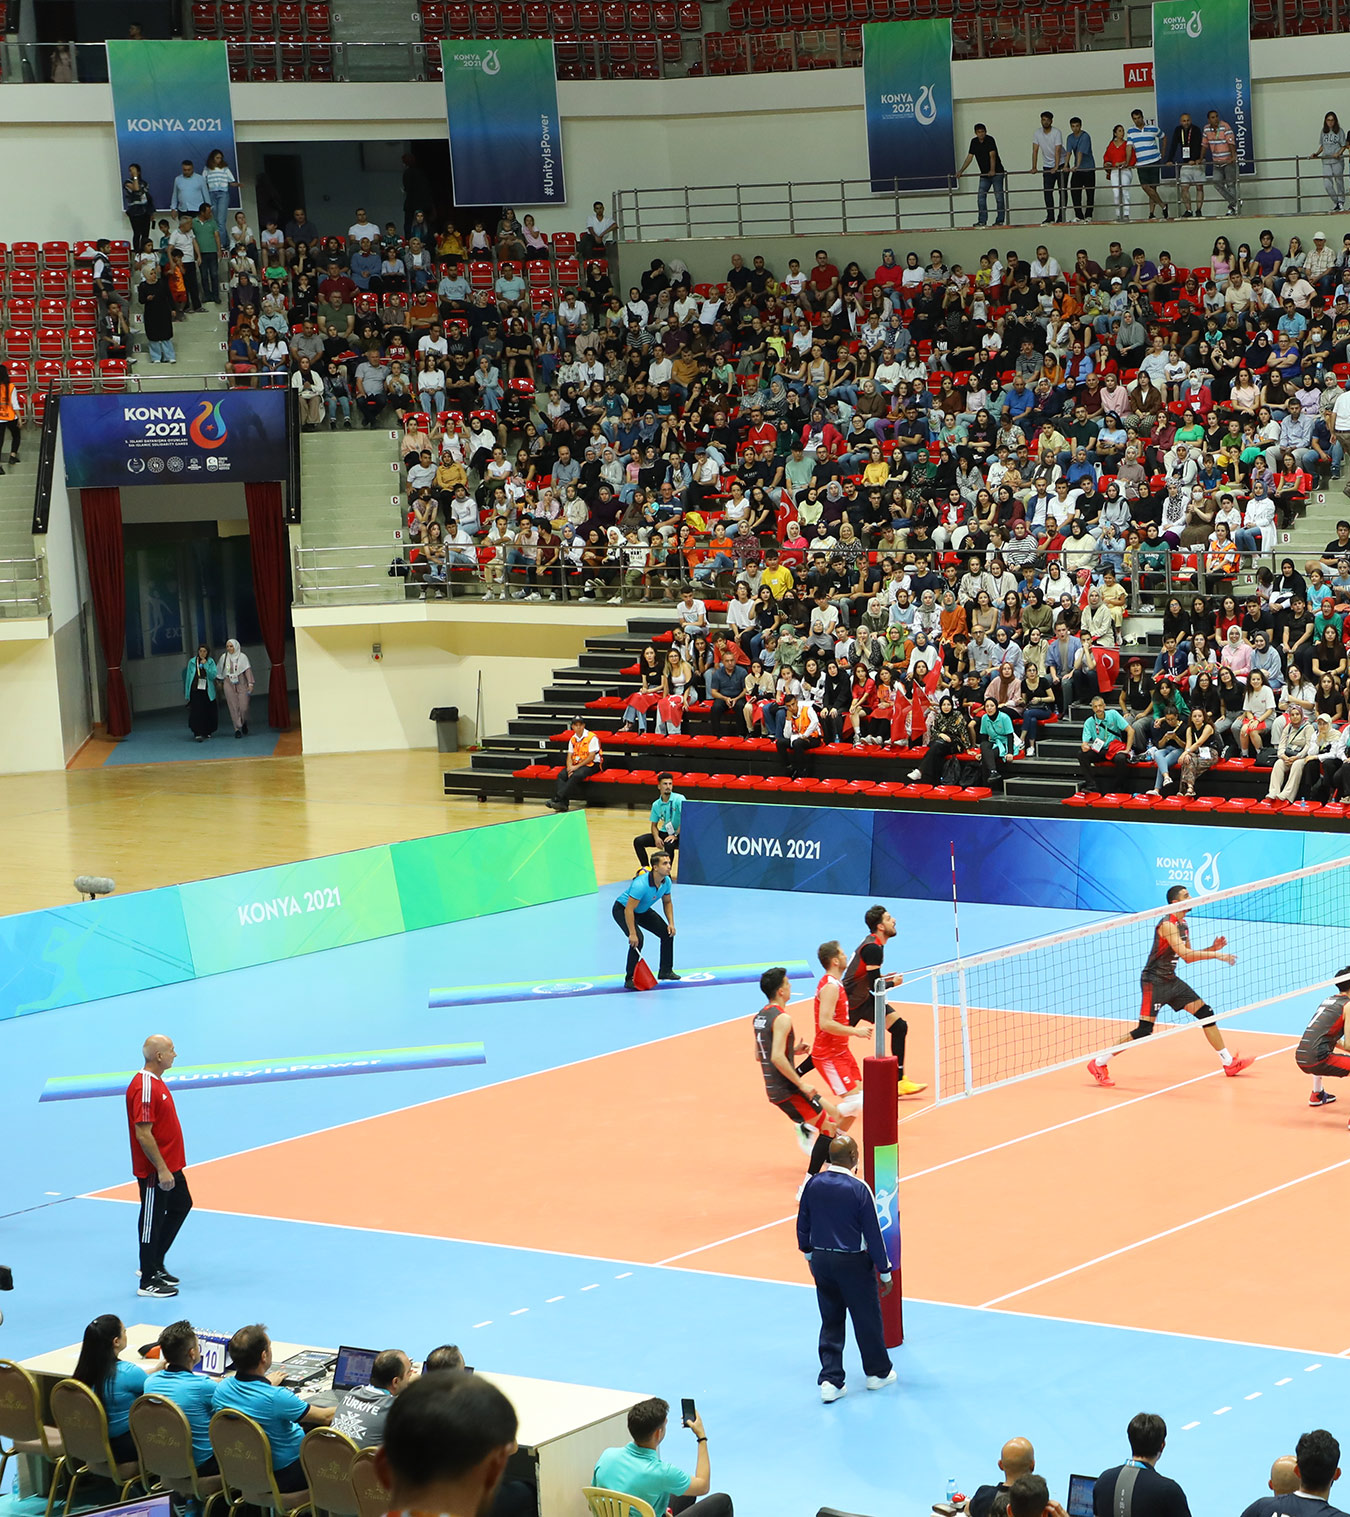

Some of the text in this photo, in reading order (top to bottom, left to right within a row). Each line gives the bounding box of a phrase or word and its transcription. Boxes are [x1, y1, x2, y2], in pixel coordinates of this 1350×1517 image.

[1128, 68, 1148, 83] ALT
[881, 93, 913, 104] KONYA
[892, 103, 914, 113] 2021
[127, 118, 222, 132] KONYA 2021
[540, 114, 555, 196] #UnityIsPower
[124, 406, 186, 421] KONYA
[145, 422, 187, 437] 2021
[727, 835, 820, 860] KONYA 2021
[1156, 857, 1194, 869] KONYA
[1168, 869, 1194, 881] 2021
[238, 886, 341, 926] KONYA 2021
[205, 1349, 217, 1370] 10
[341, 1396, 381, 1415] TÜRKİYE
